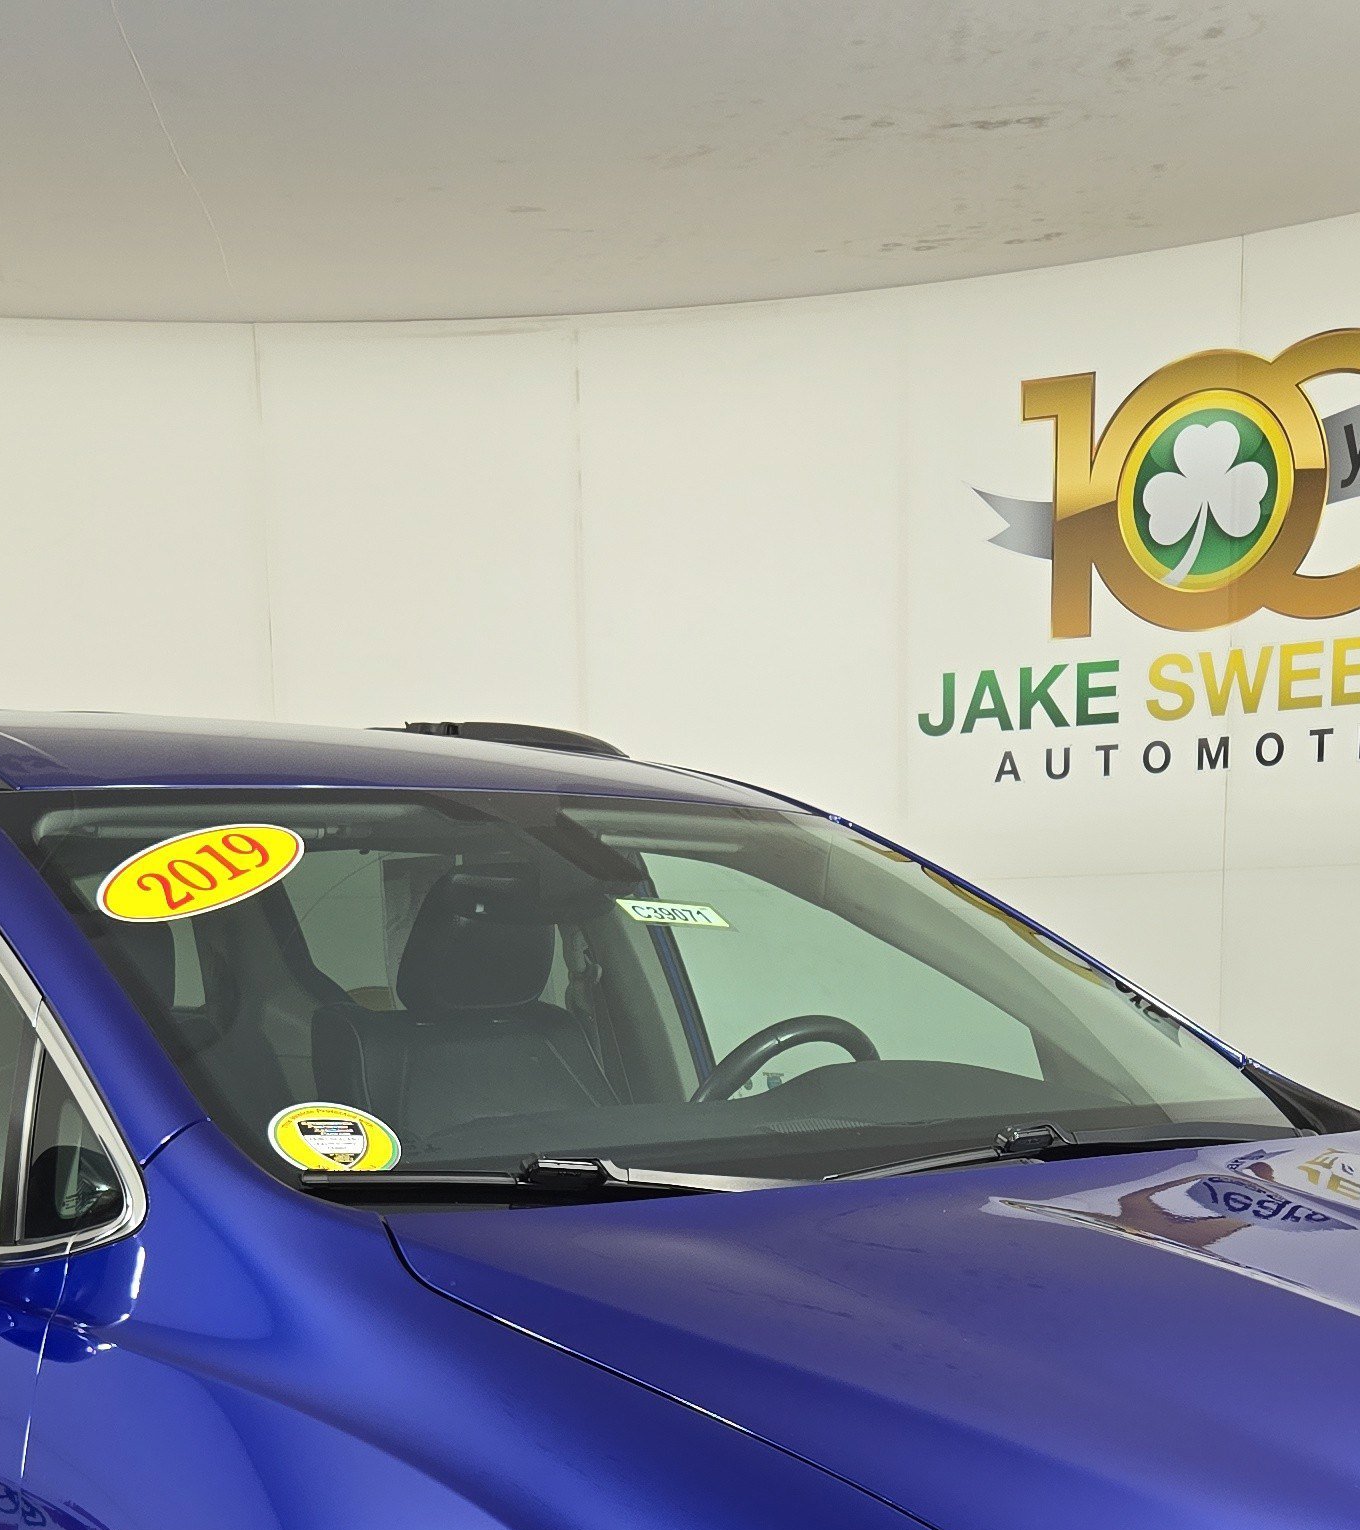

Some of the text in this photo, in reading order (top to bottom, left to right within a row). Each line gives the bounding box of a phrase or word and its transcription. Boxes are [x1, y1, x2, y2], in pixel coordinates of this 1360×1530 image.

[917, 659, 1120, 737] JAKE
[136, 833, 270, 911] 2019
[631, 904, 713, 924] C39071
